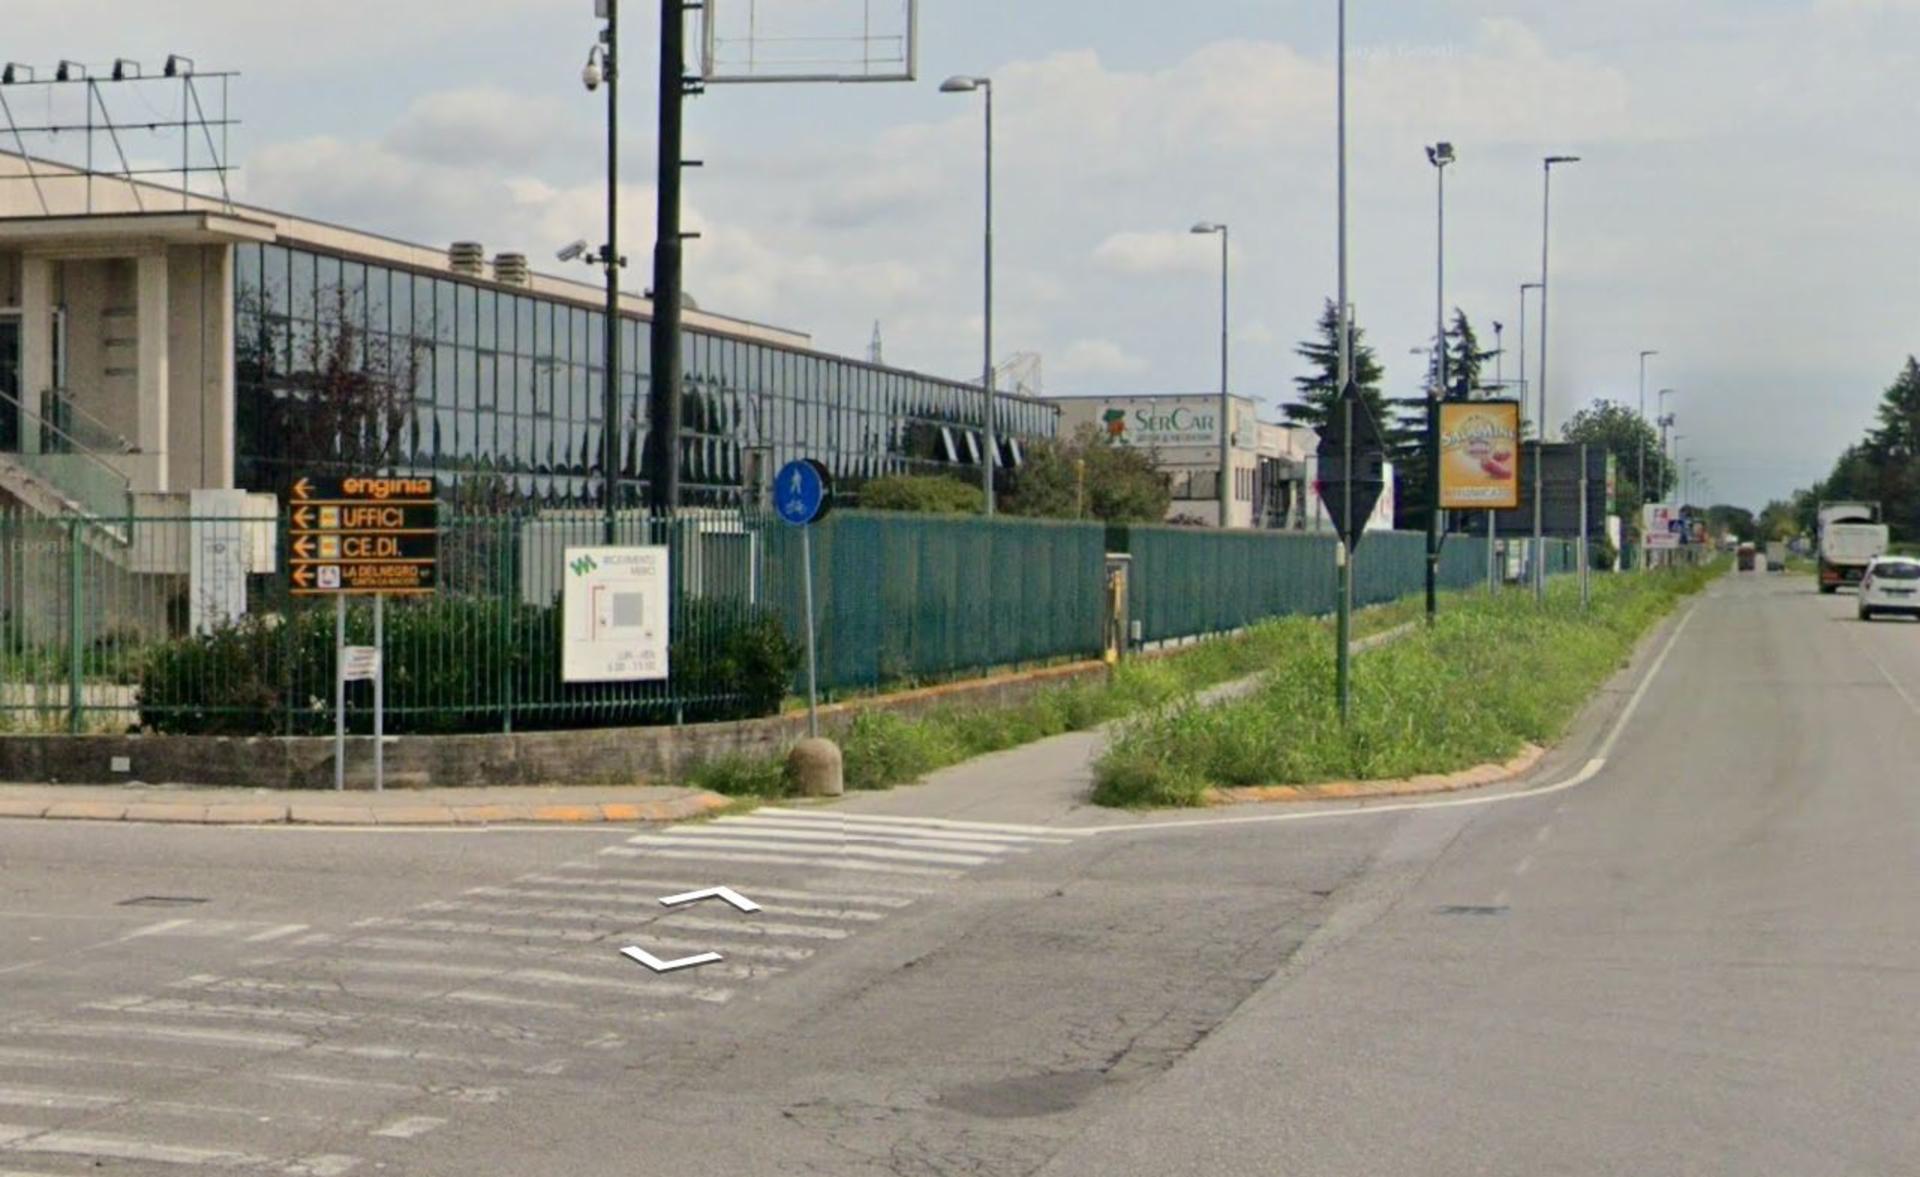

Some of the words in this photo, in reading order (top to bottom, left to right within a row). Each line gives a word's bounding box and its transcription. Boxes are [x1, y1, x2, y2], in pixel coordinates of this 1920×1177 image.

[343, 478, 431, 498] enginia
[343, 507, 404, 527] UFFICI
[343, 537, 403, 557] CE.DI.
